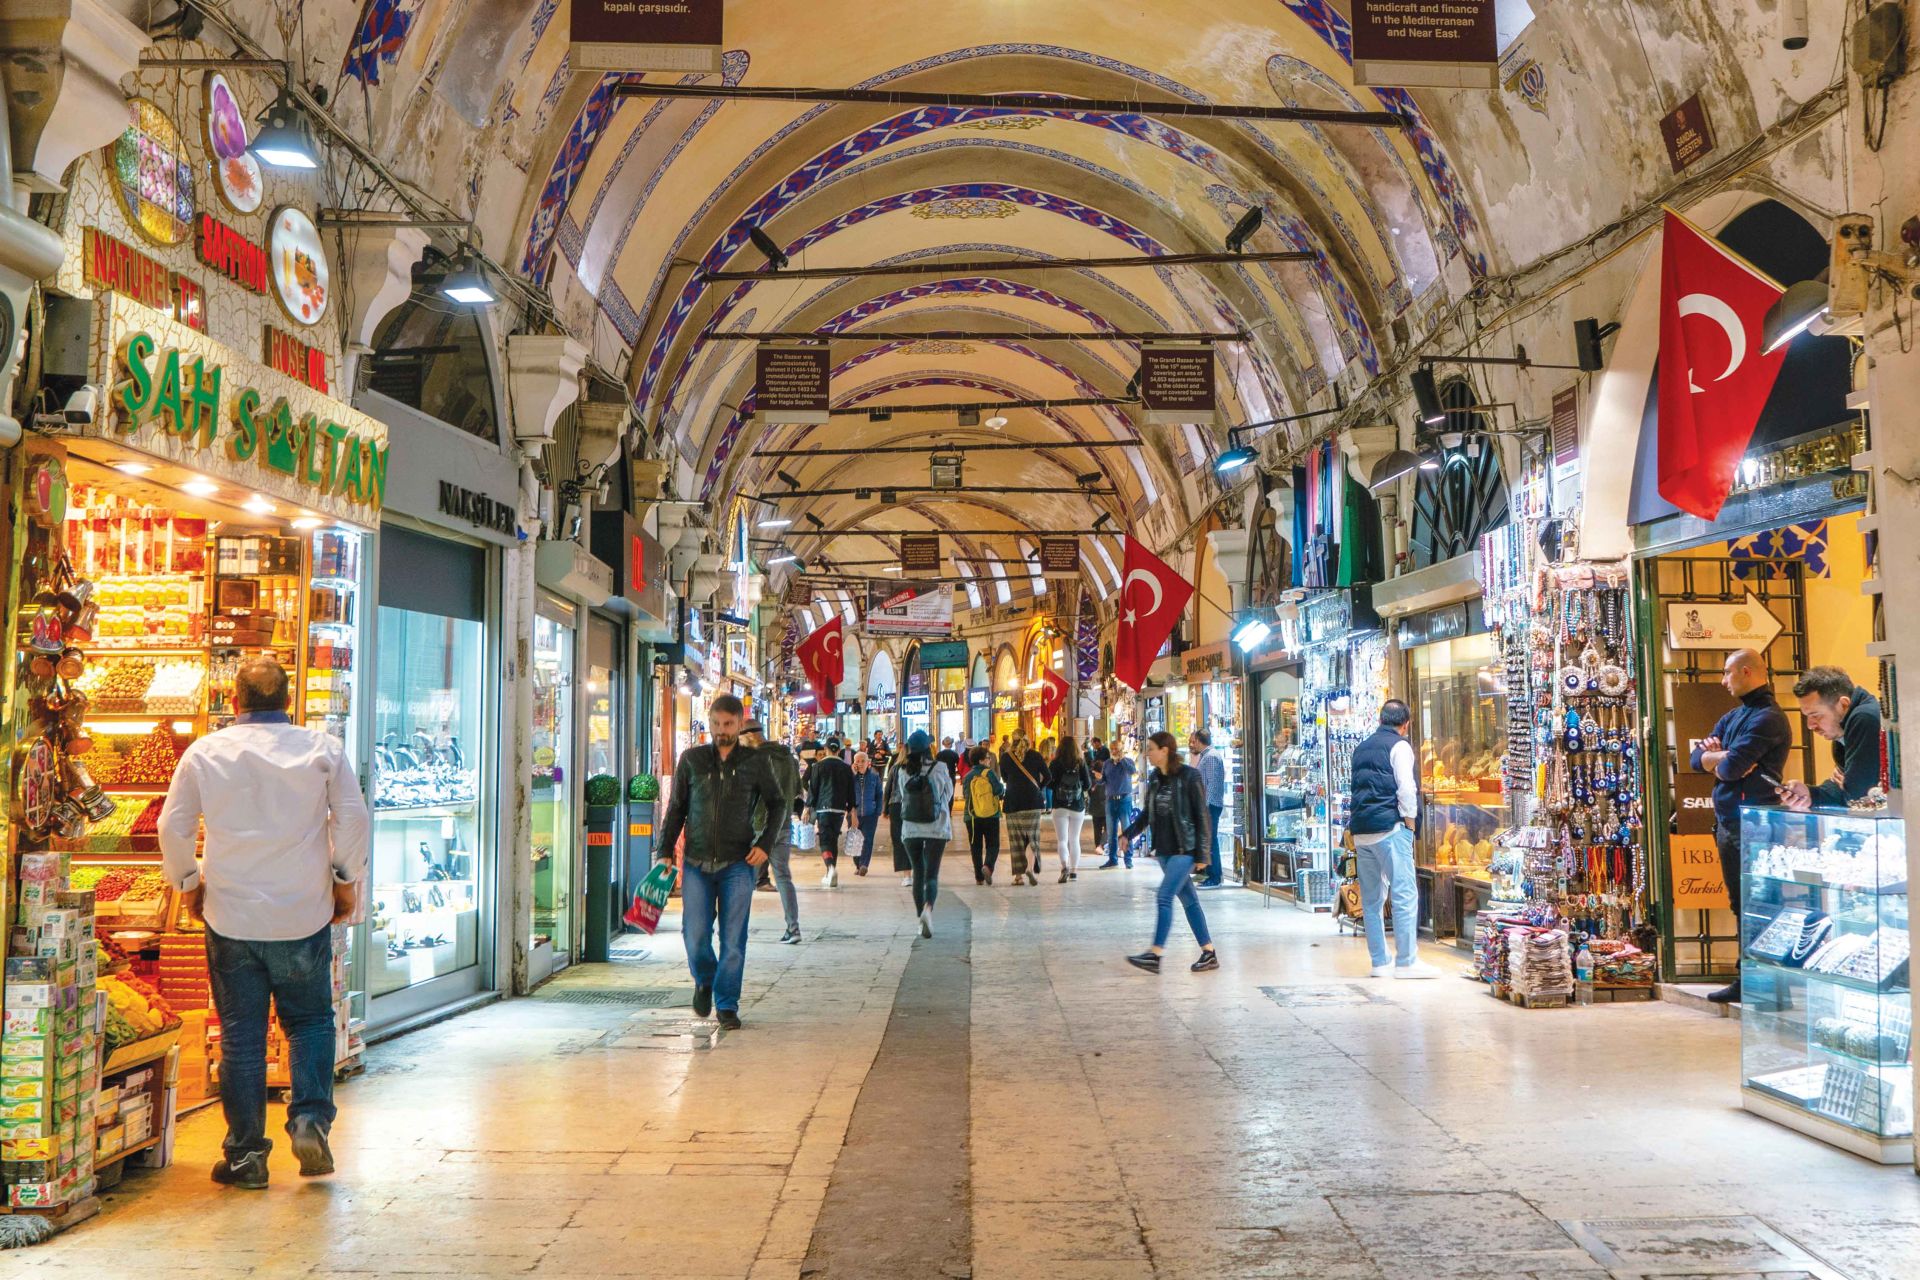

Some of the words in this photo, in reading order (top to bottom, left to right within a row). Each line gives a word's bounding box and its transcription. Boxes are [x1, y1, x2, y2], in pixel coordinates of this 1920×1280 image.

[604, 2, 636, 13] kapalı
[638, 3, 691, 15] çarşısıdır.
[1366, 2, 1418, 13] handicraft
[1420, 3, 1438, 13] and
[1441, 4, 1479, 14] finance
[1371, 15, 1381, 24] in
[1384, 15, 1400, 24] the
[1402, 15, 1475, 26] Mediterranean
[1387, 28, 1406, 37] and
[1408, 28, 1433, 38] Near
[1435, 29, 1461, 39] East.
[203, 213, 267, 295] SAFFRON
[93, 229, 173, 315] NATUREL
[271, 327, 306, 383] ROSE
[307, 346, 329, 396] OIL
[114, 332, 222, 447] ŞAH
[439, 479, 517, 538] NAKŞİLER
[939, 692, 957, 709] ALYA
[1678, 877, 1725, 896] Turkish
